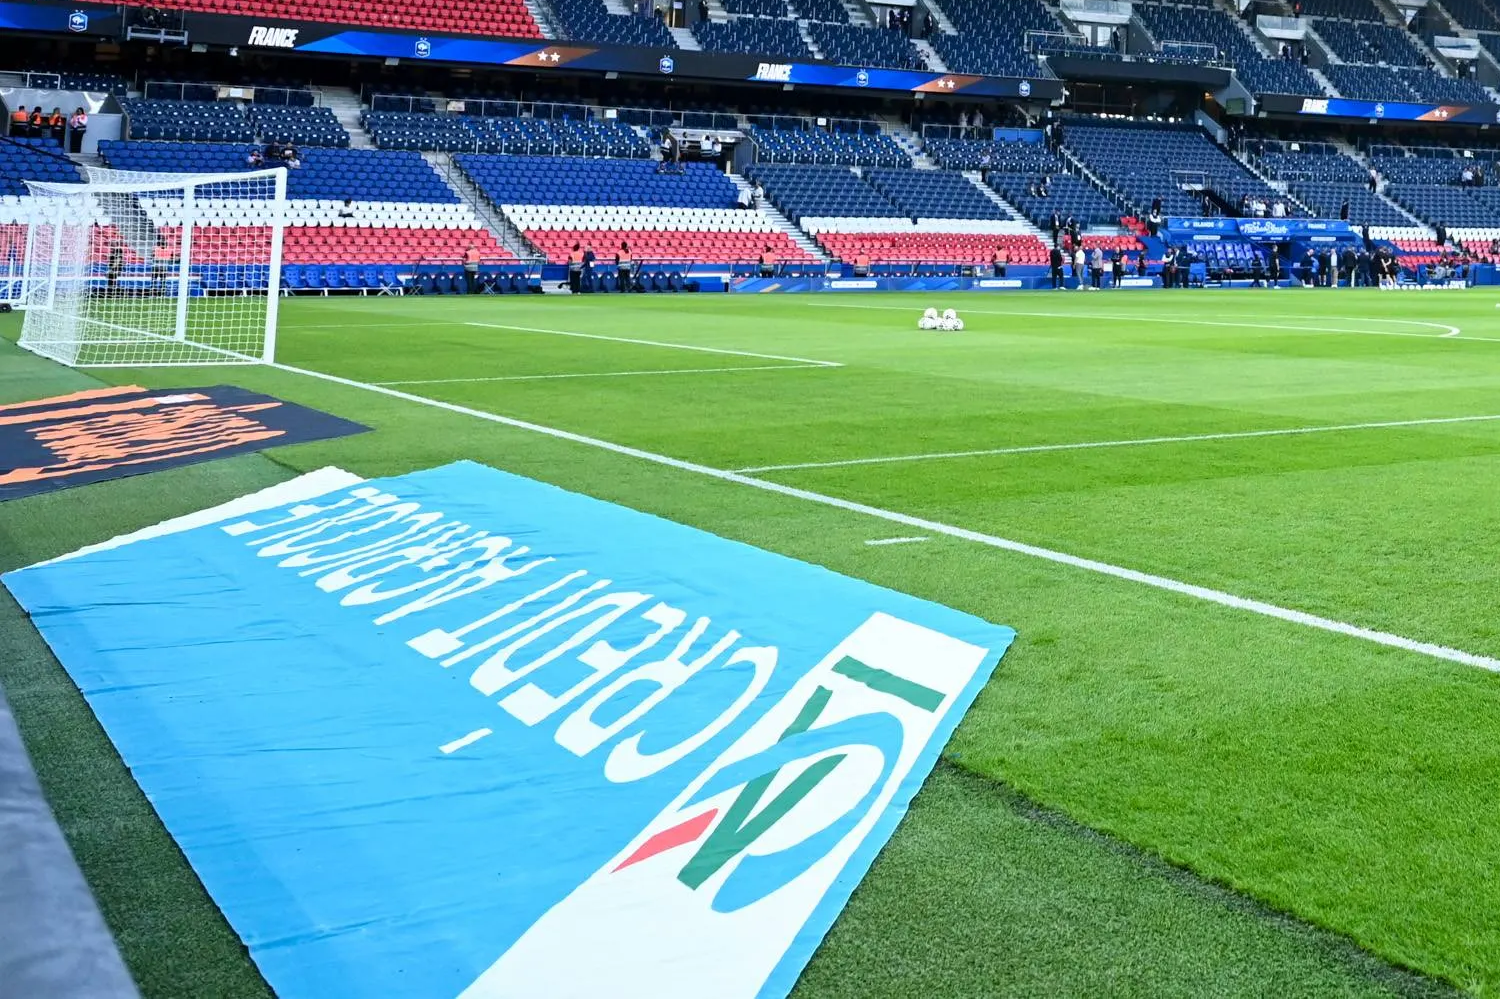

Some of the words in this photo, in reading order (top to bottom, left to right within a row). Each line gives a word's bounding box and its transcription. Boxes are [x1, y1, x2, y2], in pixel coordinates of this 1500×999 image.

[248, 26, 299, 48] FRANCE
[755, 62, 793, 81] FRANCE
[221, 486, 556, 626] AGRICOLE
[405, 569, 779, 785] CRÉDIT
